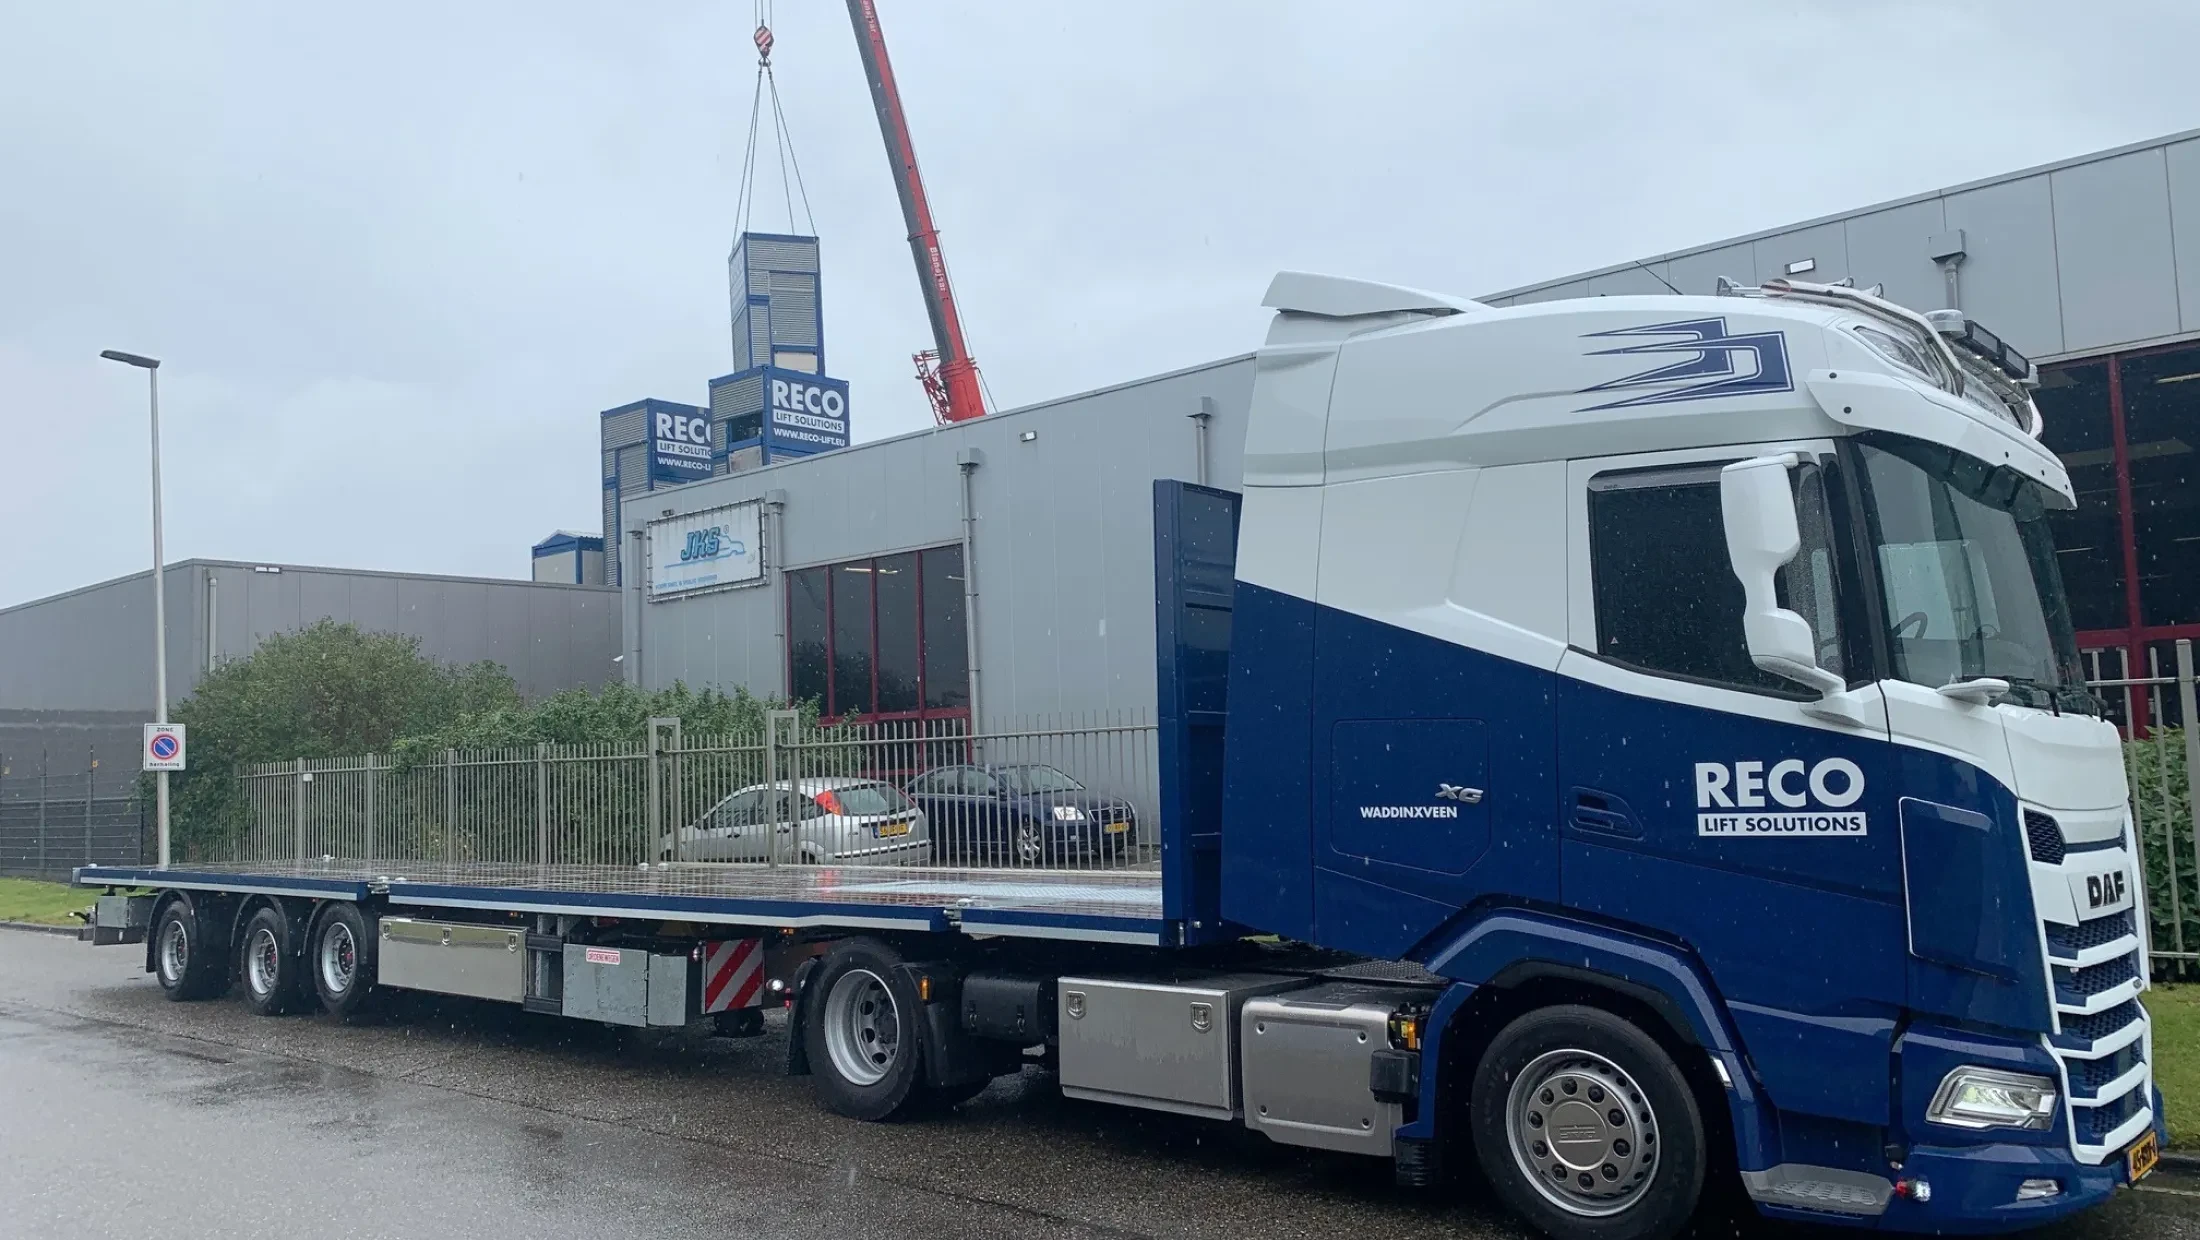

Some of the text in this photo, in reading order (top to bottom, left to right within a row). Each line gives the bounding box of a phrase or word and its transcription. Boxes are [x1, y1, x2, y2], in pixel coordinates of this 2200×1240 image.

[772, 379, 844, 418] RECO
[776, 412, 843, 431] LIFT SOLUTIONS
[660, 442, 675, 452] LIFT
[773, 427, 846, 447] WWW.RECO-LIFT.EU
[681, 526, 721, 561] JKS
[1695, 757, 1865, 808] RECO
[1435, 783, 1484, 804] XG
[1360, 806, 1458, 819] WADDINXVEEN
[1704, 816, 1861, 832] LIFT SOLUTIONS
[2086, 870, 2125, 908] DAF
